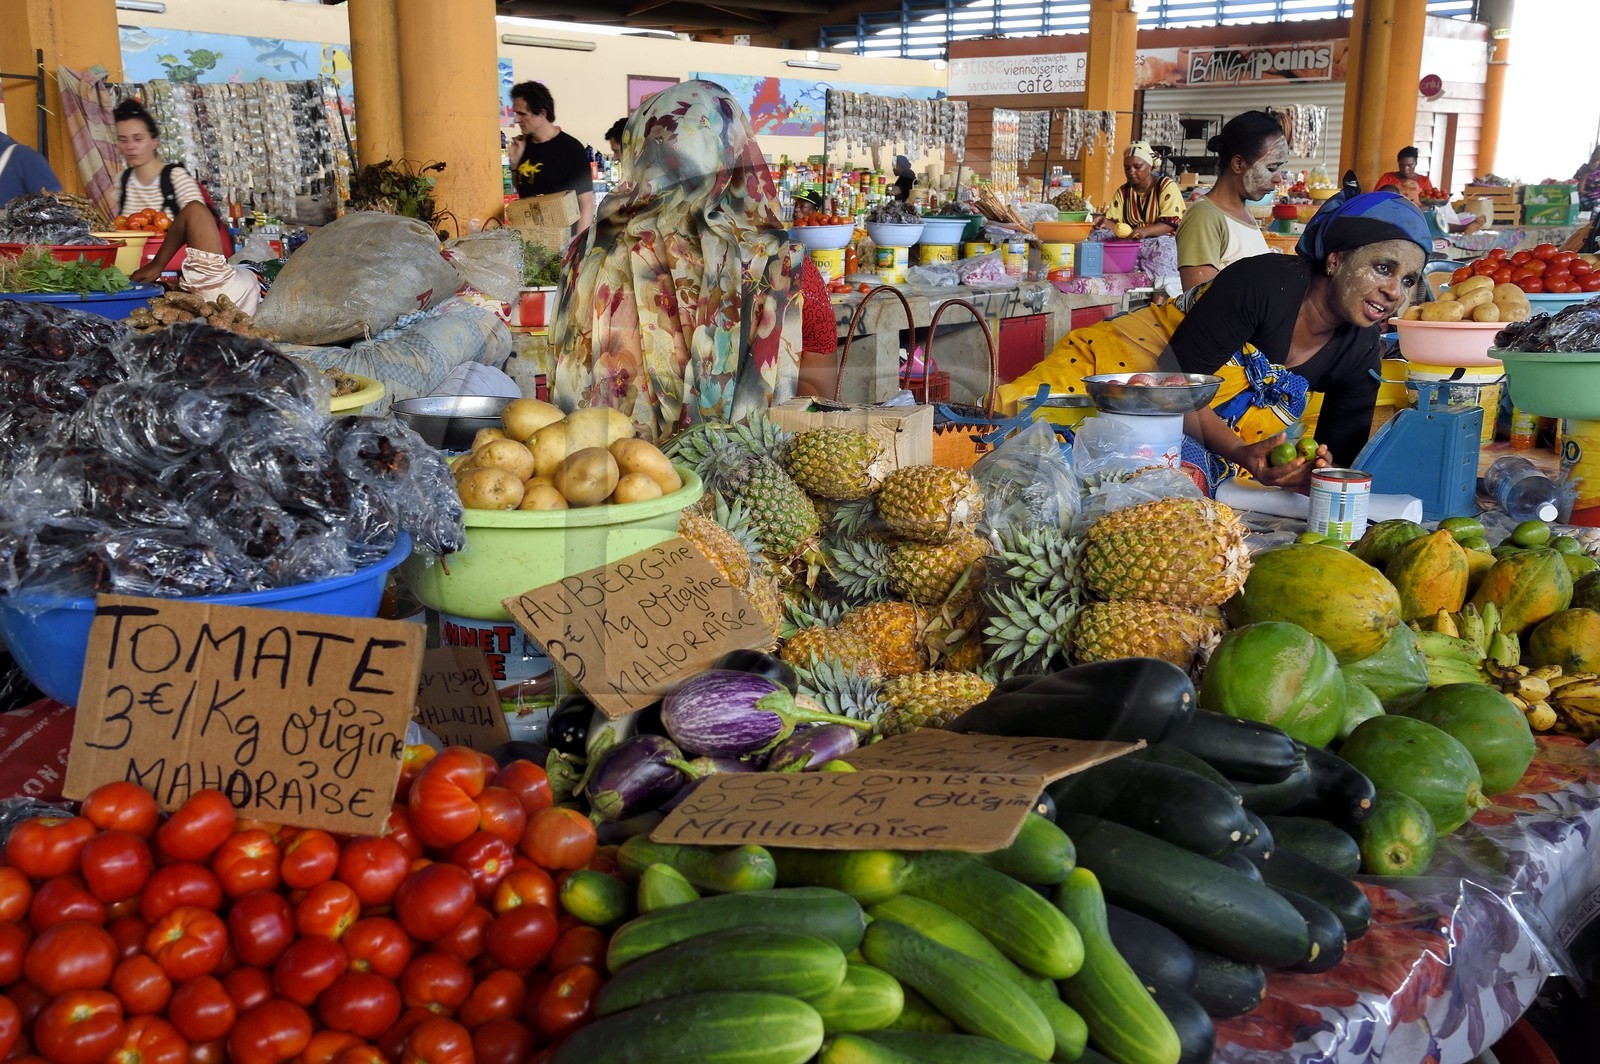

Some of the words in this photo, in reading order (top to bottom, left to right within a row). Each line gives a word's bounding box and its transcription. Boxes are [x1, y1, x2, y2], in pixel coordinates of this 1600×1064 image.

[1003, 62, 1069, 76] viennoiseries
[1077, 57, 1085, 72] p
[1190, 50, 1256, 86] BANGA
[1255, 44, 1330, 79] pains
[1017, 75, 1053, 93] café
[1058, 76, 1086, 88] boisso
[441, 622, 516, 654] NNET
[95, 604, 406, 695] TOMATE
